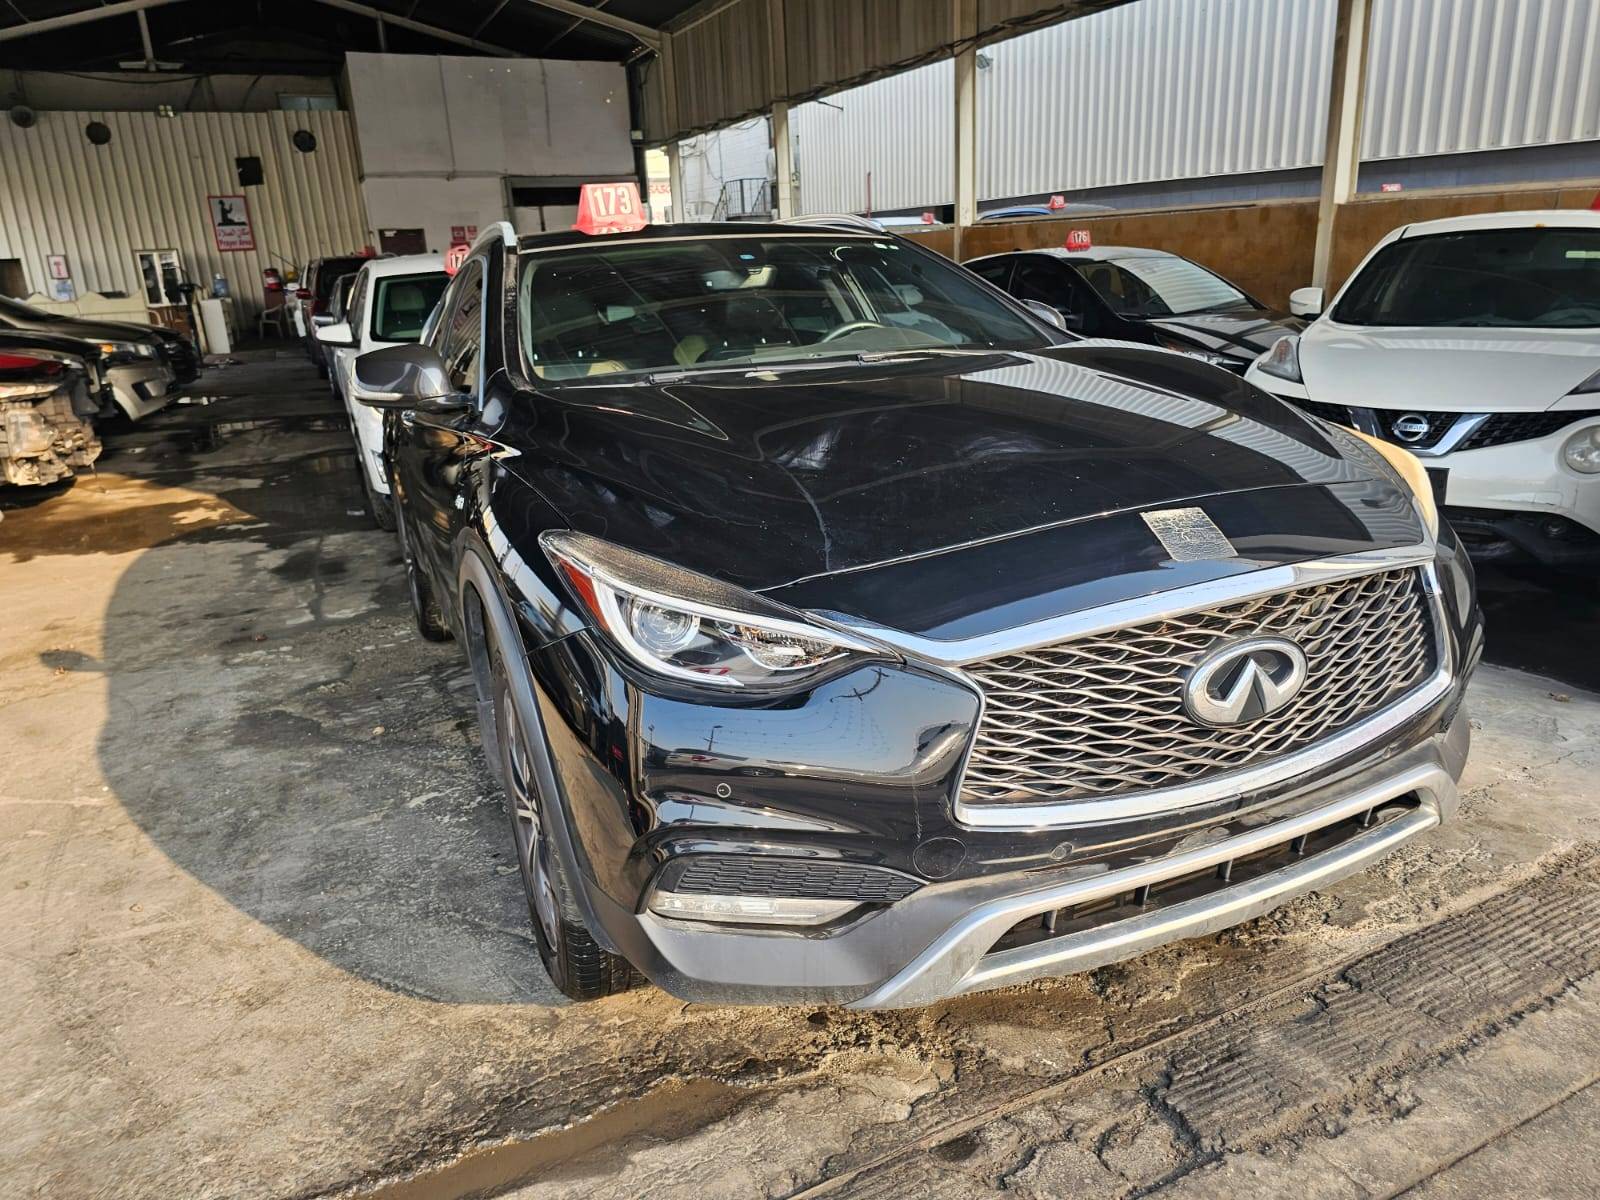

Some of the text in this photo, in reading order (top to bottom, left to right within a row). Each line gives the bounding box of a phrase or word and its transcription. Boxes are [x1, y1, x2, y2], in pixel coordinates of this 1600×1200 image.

[594, 187, 632, 216] 173
[1074, 231, 1088, 243] 176
[219, 240, 237, 248] Prayer
[451, 253, 468, 268] 17
